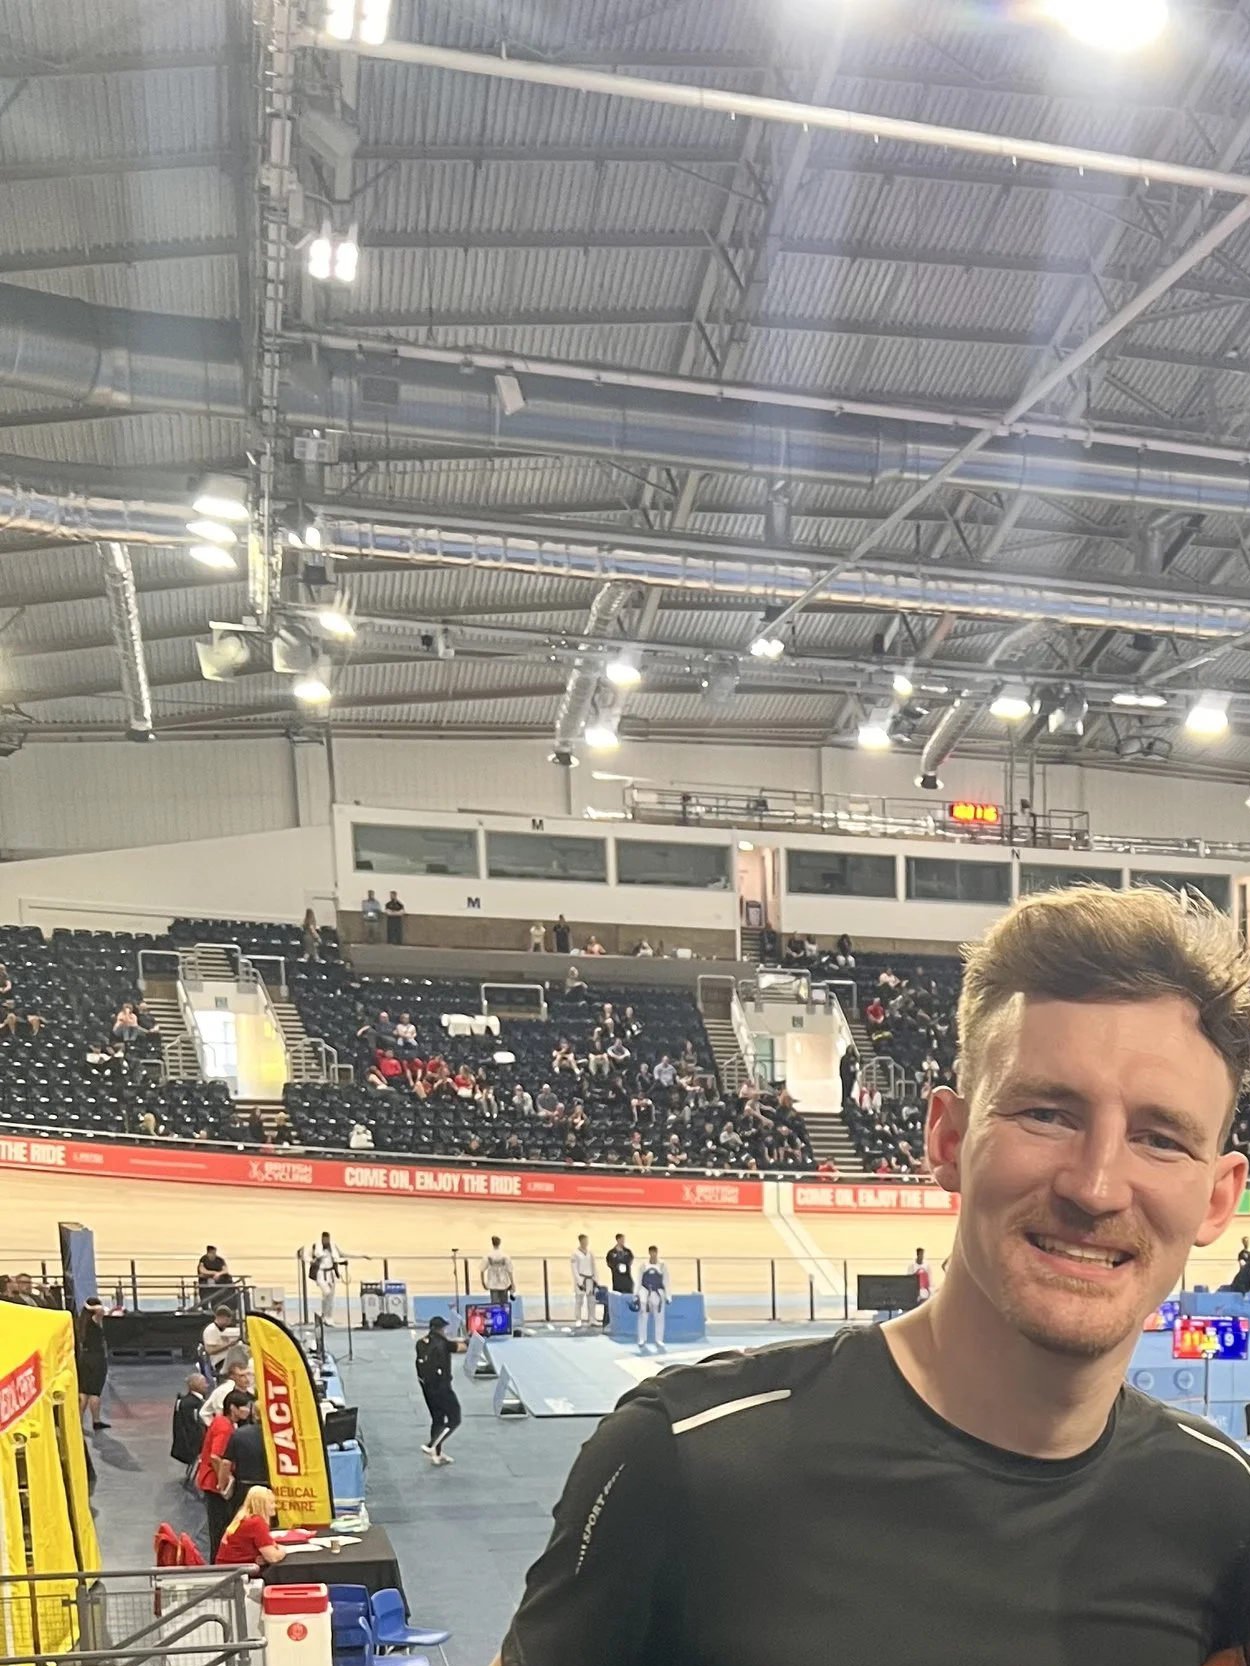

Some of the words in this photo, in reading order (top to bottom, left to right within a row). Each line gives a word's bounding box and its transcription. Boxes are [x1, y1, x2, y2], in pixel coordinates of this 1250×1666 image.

[531, 818, 544, 831] M
[1011, 848, 1020, 859] N
[467, 897, 481, 909] M
[0, 1141, 28, 1162] THE
[30, 1143, 66, 1166] RIDE
[344, 1167, 388, 1188] COME
[389, 1169, 414, 1192] ON,
[415, 1170, 461, 1193] ENJOY
[462, 1174, 488, 1194] THE
[490, 1175, 522, 1195] RIDE
[267, 1379, 299, 1474] PACT
[582, 1493, 605, 1544] SPORT
